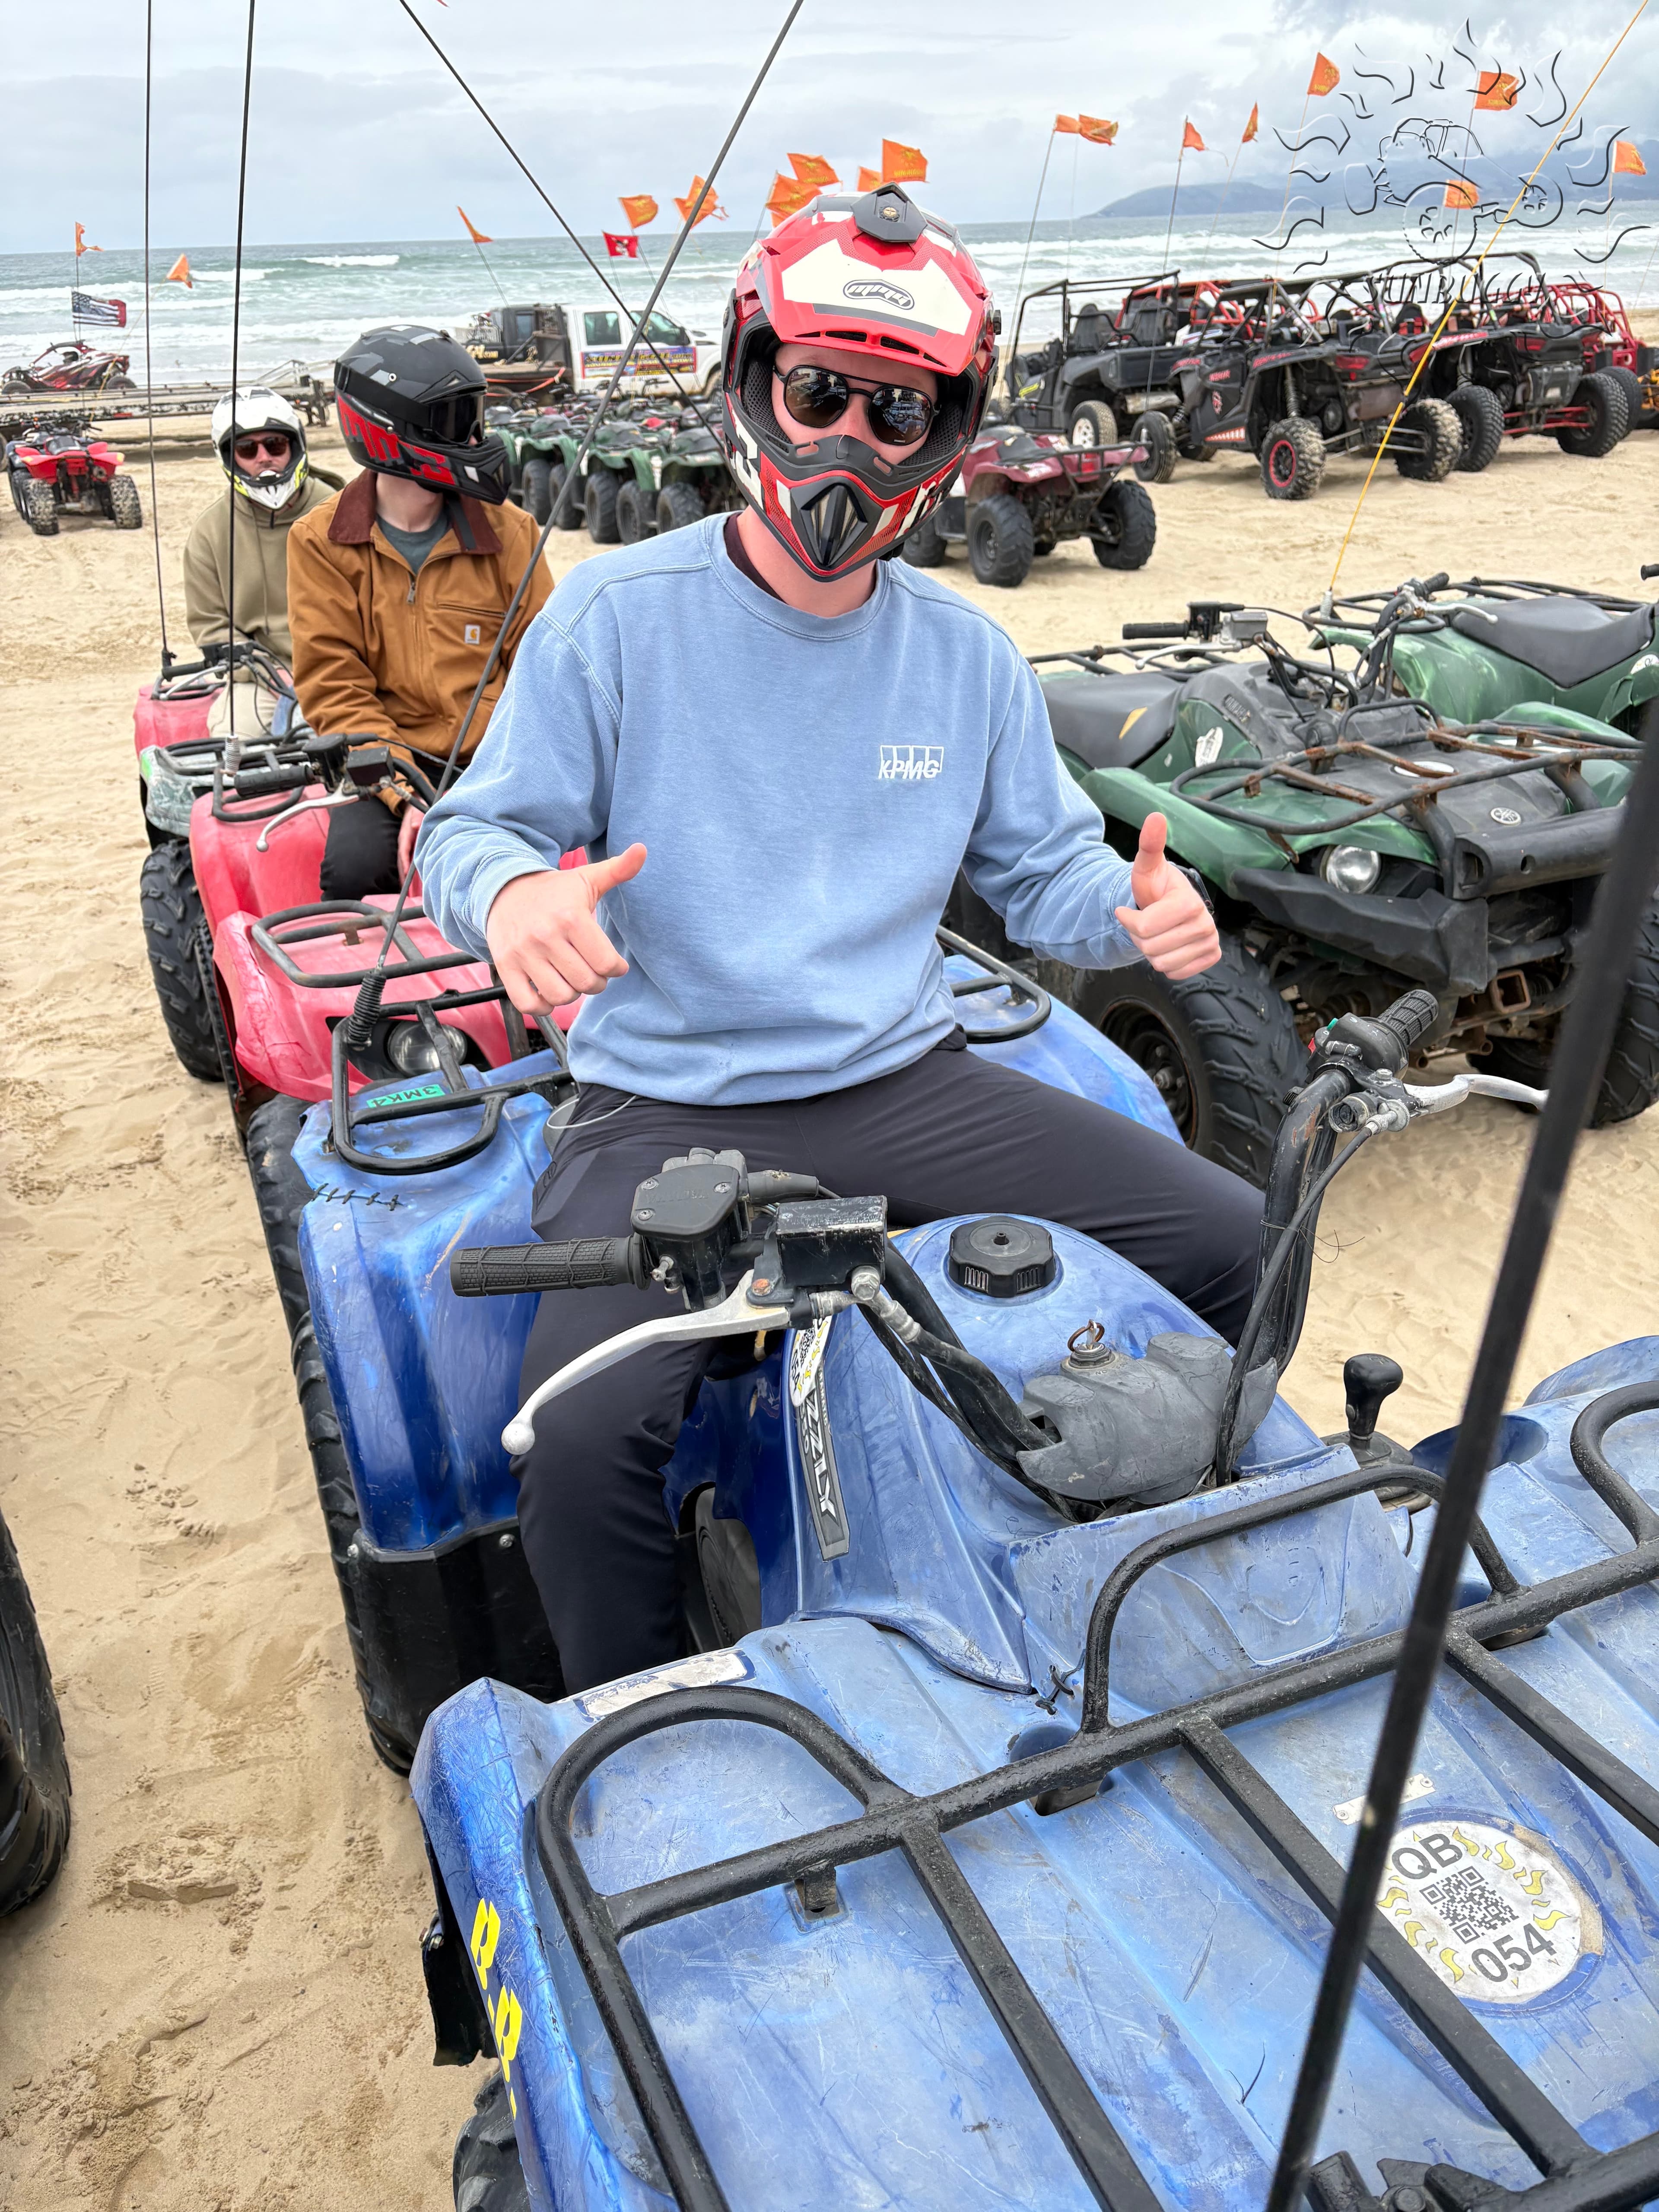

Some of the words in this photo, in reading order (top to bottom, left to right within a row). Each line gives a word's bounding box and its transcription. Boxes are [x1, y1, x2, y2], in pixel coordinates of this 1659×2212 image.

[878, 760, 939, 779] KPMG
[791, 1348, 801, 1396] 054
[806, 1388, 839, 1526] ZZLY
[1392, 1833, 1463, 1880] QB
[1471, 1923, 1557, 1983] 054
